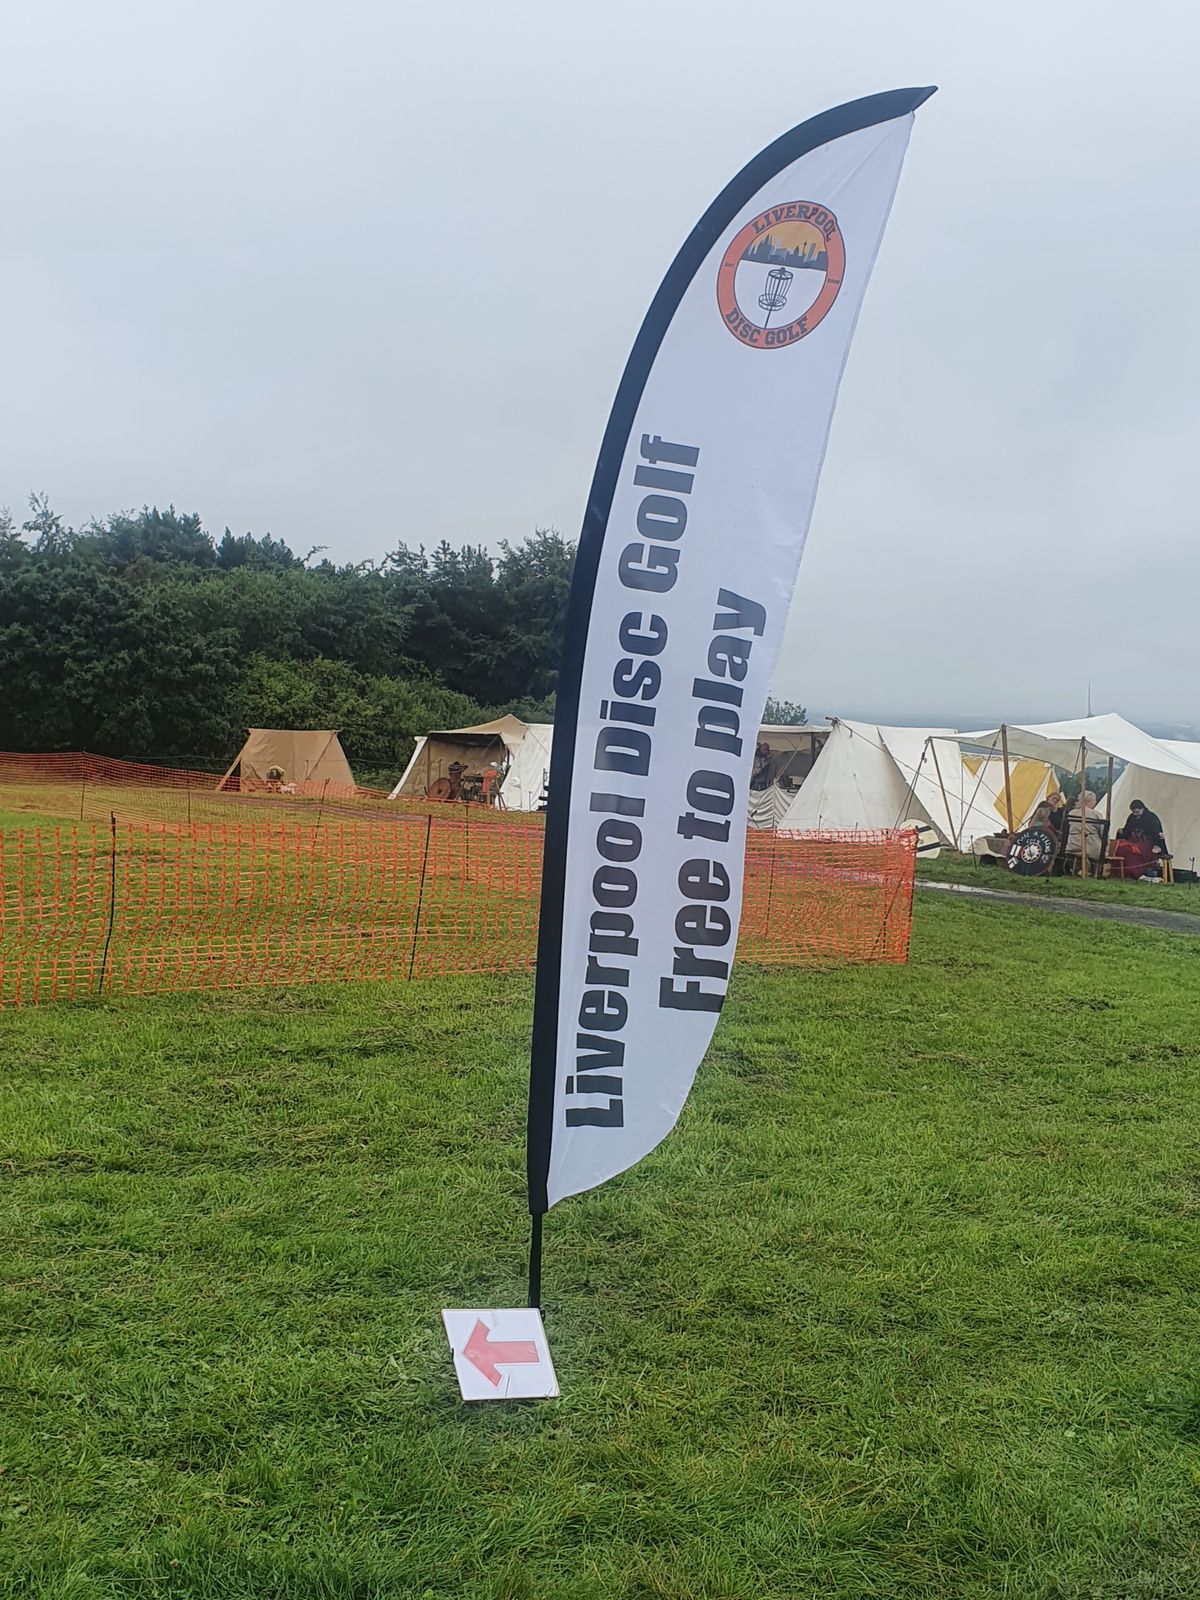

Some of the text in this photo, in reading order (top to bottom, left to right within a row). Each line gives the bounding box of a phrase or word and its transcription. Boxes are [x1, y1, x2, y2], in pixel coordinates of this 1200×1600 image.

[725, 307, 809, 346] DISC GOLF
[752, 205, 837, 242] LIVERPOOL
[565, 433, 700, 1128] Liverpool Disc Golf
[659, 587, 767, 1014] Free to play
